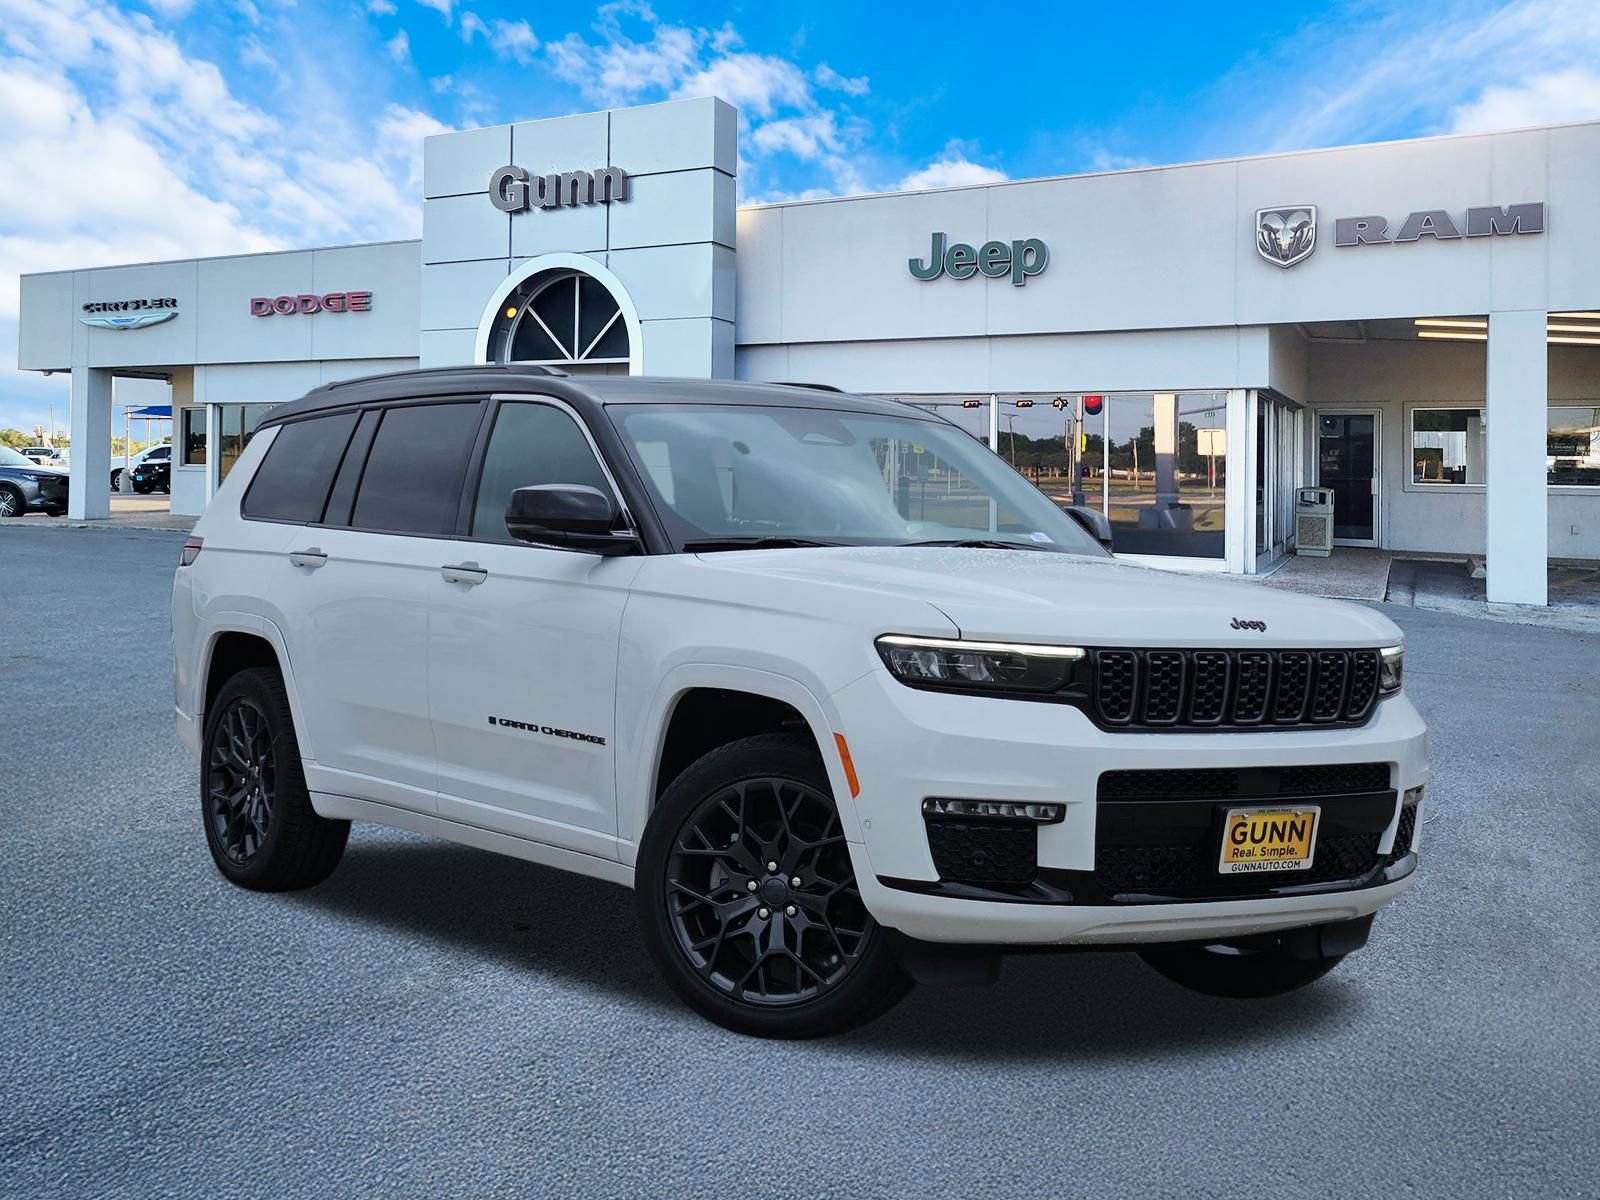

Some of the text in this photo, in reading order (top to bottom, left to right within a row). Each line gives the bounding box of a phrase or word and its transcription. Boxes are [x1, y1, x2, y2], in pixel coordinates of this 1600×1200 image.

[489, 165, 628, 213] Gunn
[1335, 202, 1546, 247] RAM
[908, 232, 1050, 287] Jeep
[82, 298, 178, 313] CHRYSLER
[250, 291, 373, 317] DODGE
[1230, 617, 1267, 633] Jeep
[499, 718, 606, 745] GRAND CHEROKEE
[1231, 820, 1306, 845] GUNN
[1232, 845, 1298, 858] Real. Simple.
[1231, 860, 1301, 872] GUNNAUTO.COM
